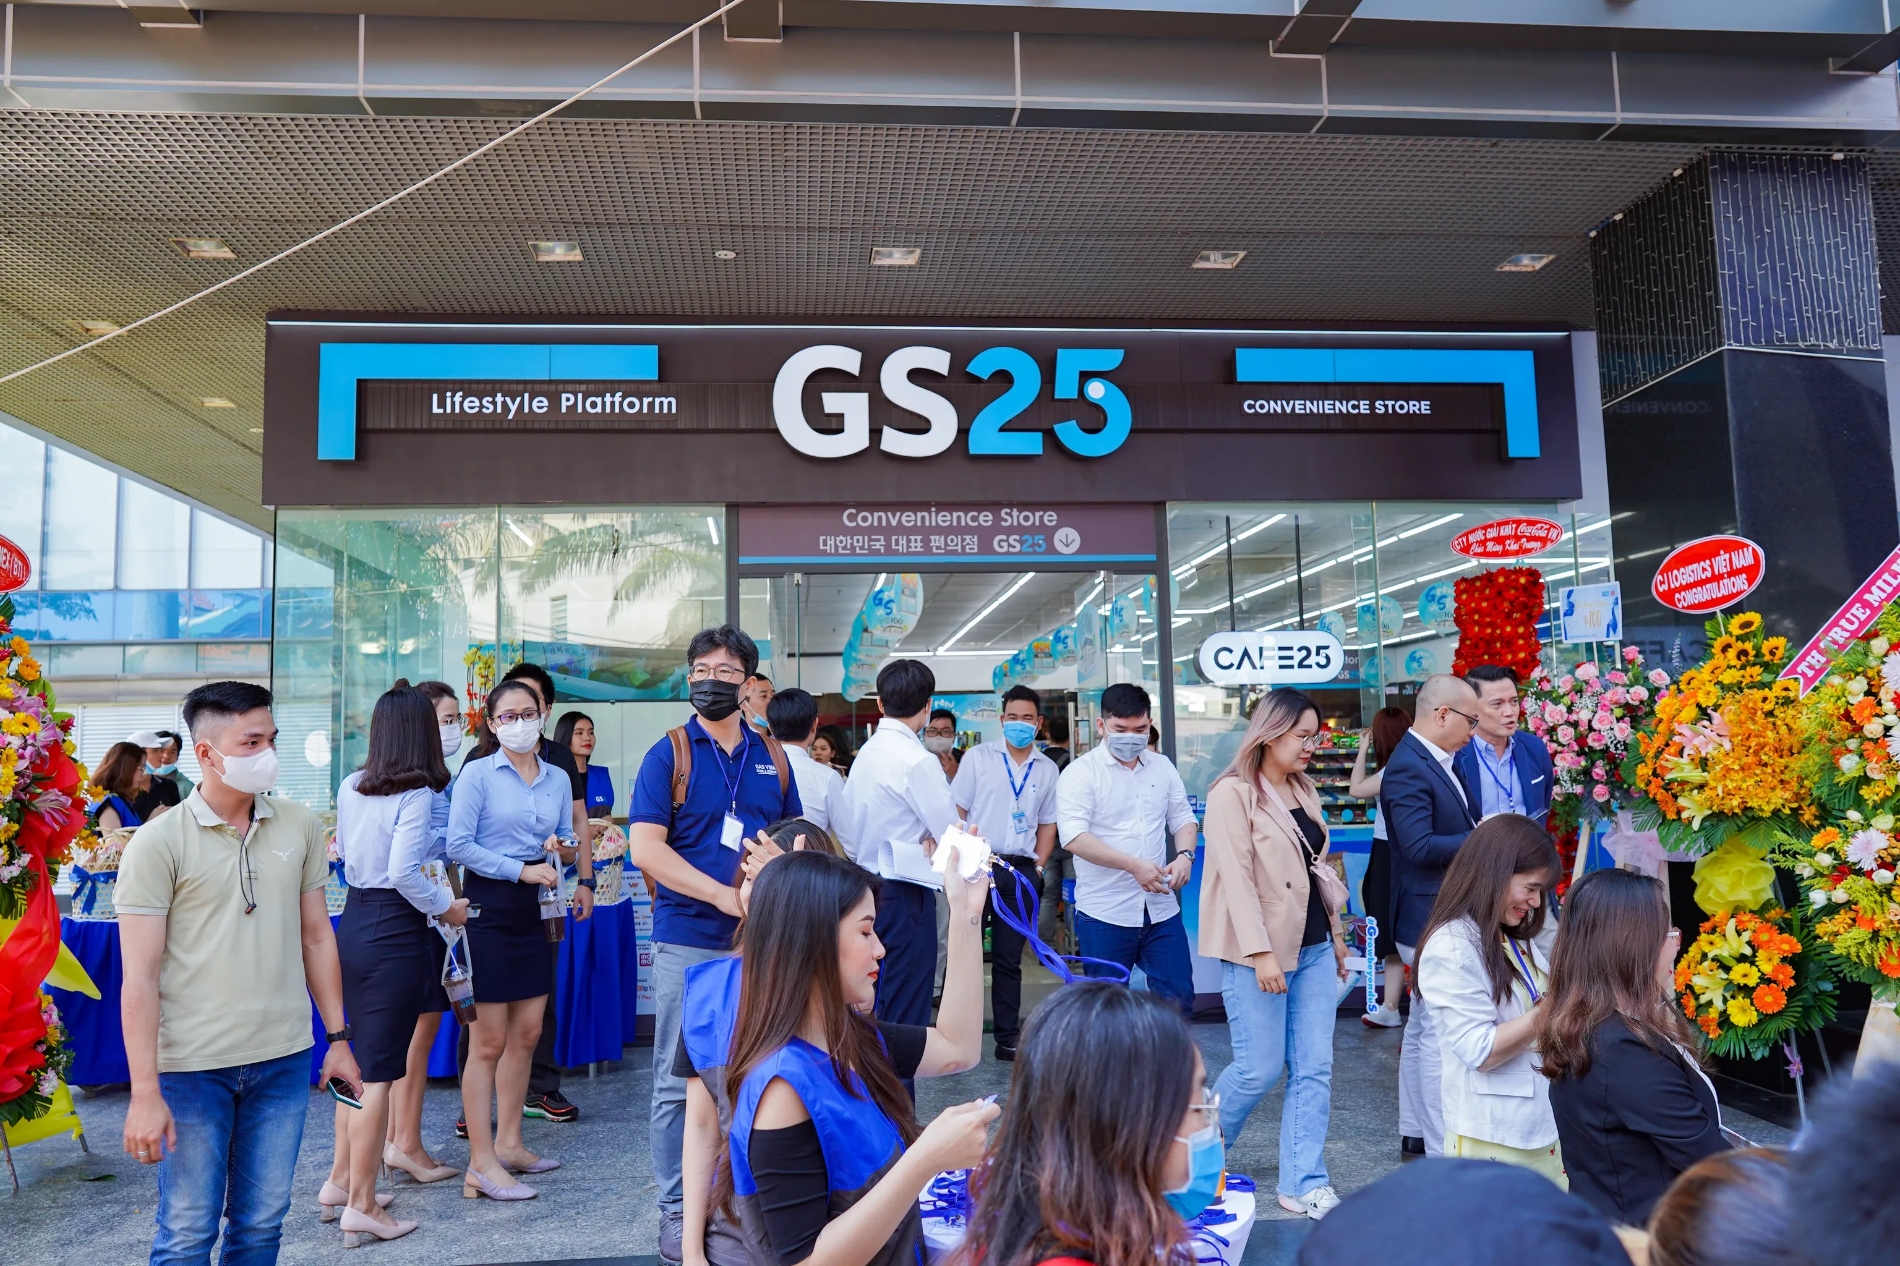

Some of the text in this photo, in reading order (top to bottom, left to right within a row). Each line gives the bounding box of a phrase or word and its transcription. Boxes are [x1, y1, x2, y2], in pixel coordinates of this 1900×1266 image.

[431, 391, 677, 420] Lifestyle Platform
[773, 344, 1132, 458] GS25
[1243, 399, 1431, 415] CONVENIENCE STORE
[842, 507, 1058, 527] Convenience Store
[818, 535, 978, 554] 대한민국 대표 편의점
[992, 534, 1047, 553] GS25
[1657, 573, 1669, 593] CJ
[1668, 559, 1713, 590] LOGISTICS
[1730, 545, 1755, 570] NAM
[1674, 573, 1749, 609] CONGRATULATIONS
[1796, 650, 1827, 678] TH
[1819, 602, 1871, 650] TRUE
[1213, 645, 1331, 671] CAFE25
